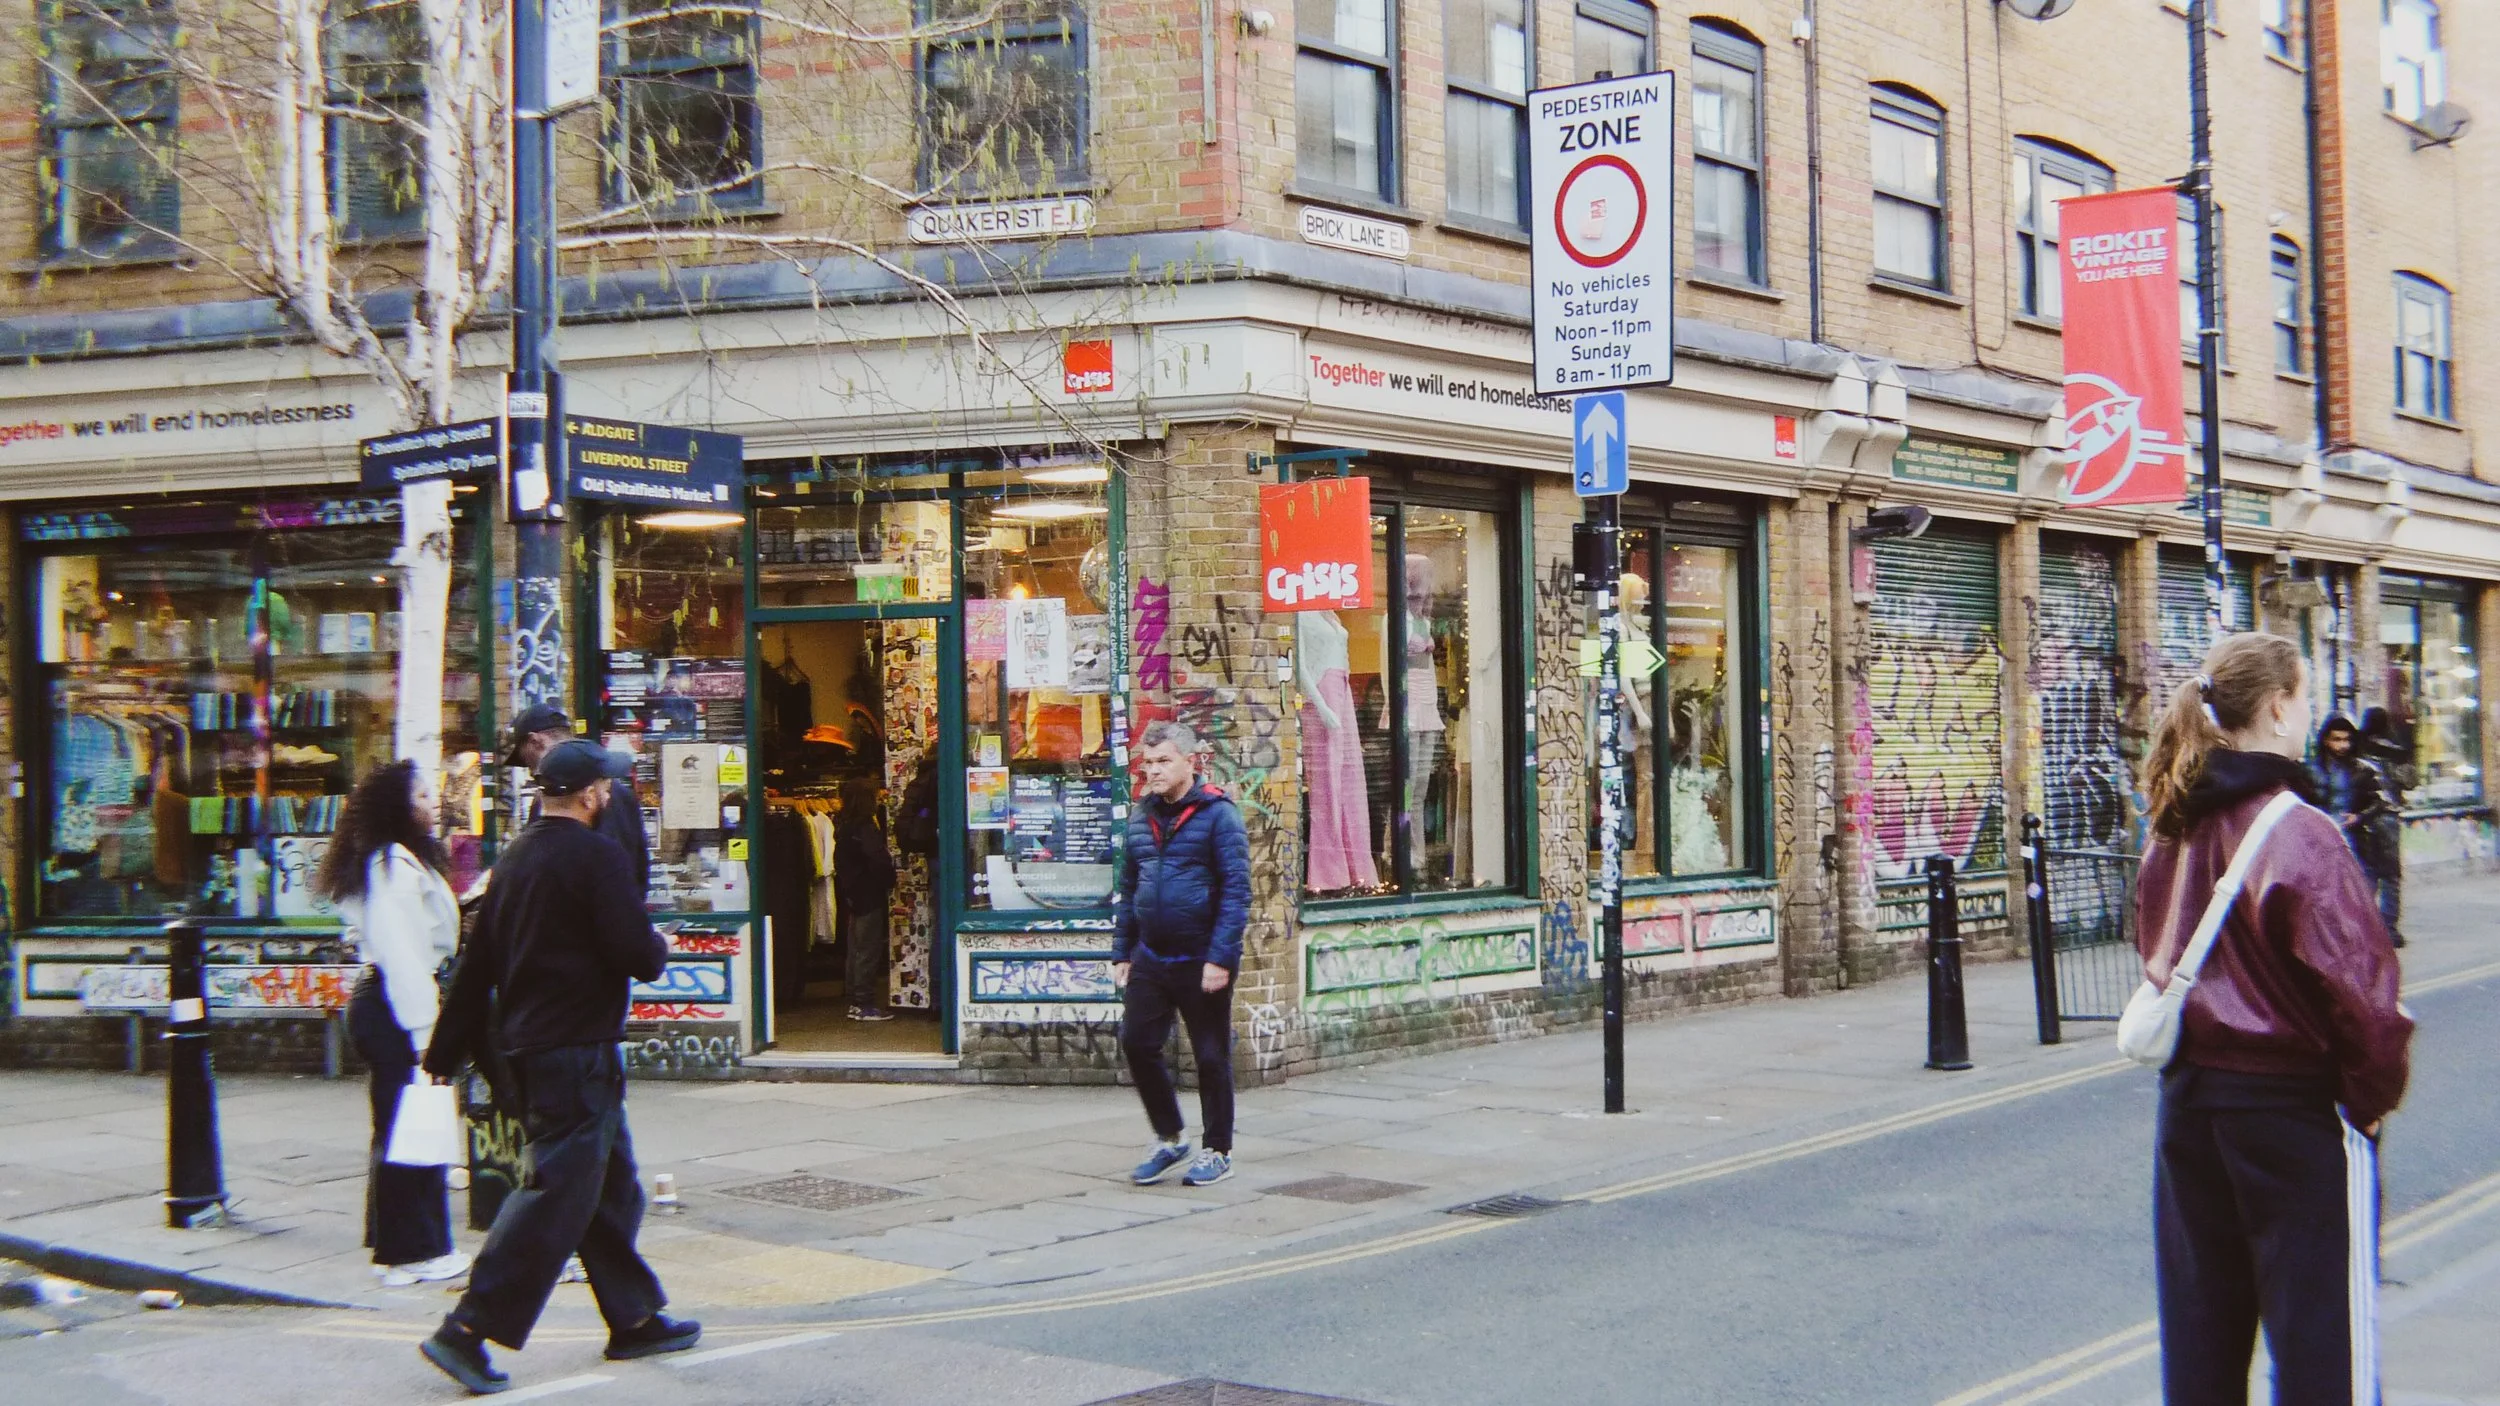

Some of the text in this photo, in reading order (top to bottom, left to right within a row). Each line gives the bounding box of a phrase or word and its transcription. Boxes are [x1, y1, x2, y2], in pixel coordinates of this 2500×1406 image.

[1542, 86, 1658, 119] PEDESTRIAN
[1560, 115, 1641, 153] ZONE
[923, 210, 1010, 235] QUAKER
[1306, 214, 1344, 241] BRICK
[1350, 223, 1385, 248] LANE
[2069, 227, 2168, 256] ROKIT
[2071, 247, 2168, 269] VINTAGE
[1551, 273, 1651, 298] No vehicles
[2076, 263, 2163, 283] YOU ARE HERE
[1563, 296, 1639, 318] Saturday
[1571, 342, 1631, 361] Sunday
[1067, 371, 1111, 390] Crisis
[1309, 355, 1573, 414] Together we will end homelessnes
[72, 420, 104, 438] we
[109, 412, 148, 434] will
[153, 409, 196, 433] end
[200, 401, 355, 430] homelessness
[581, 422, 636, 441] ALDGATE
[581, 449, 689, 474] LIVERPOOL STREET
[580, 476, 713, 503] Old Spitalfields Market
[1266, 561, 1360, 605] Crisis
